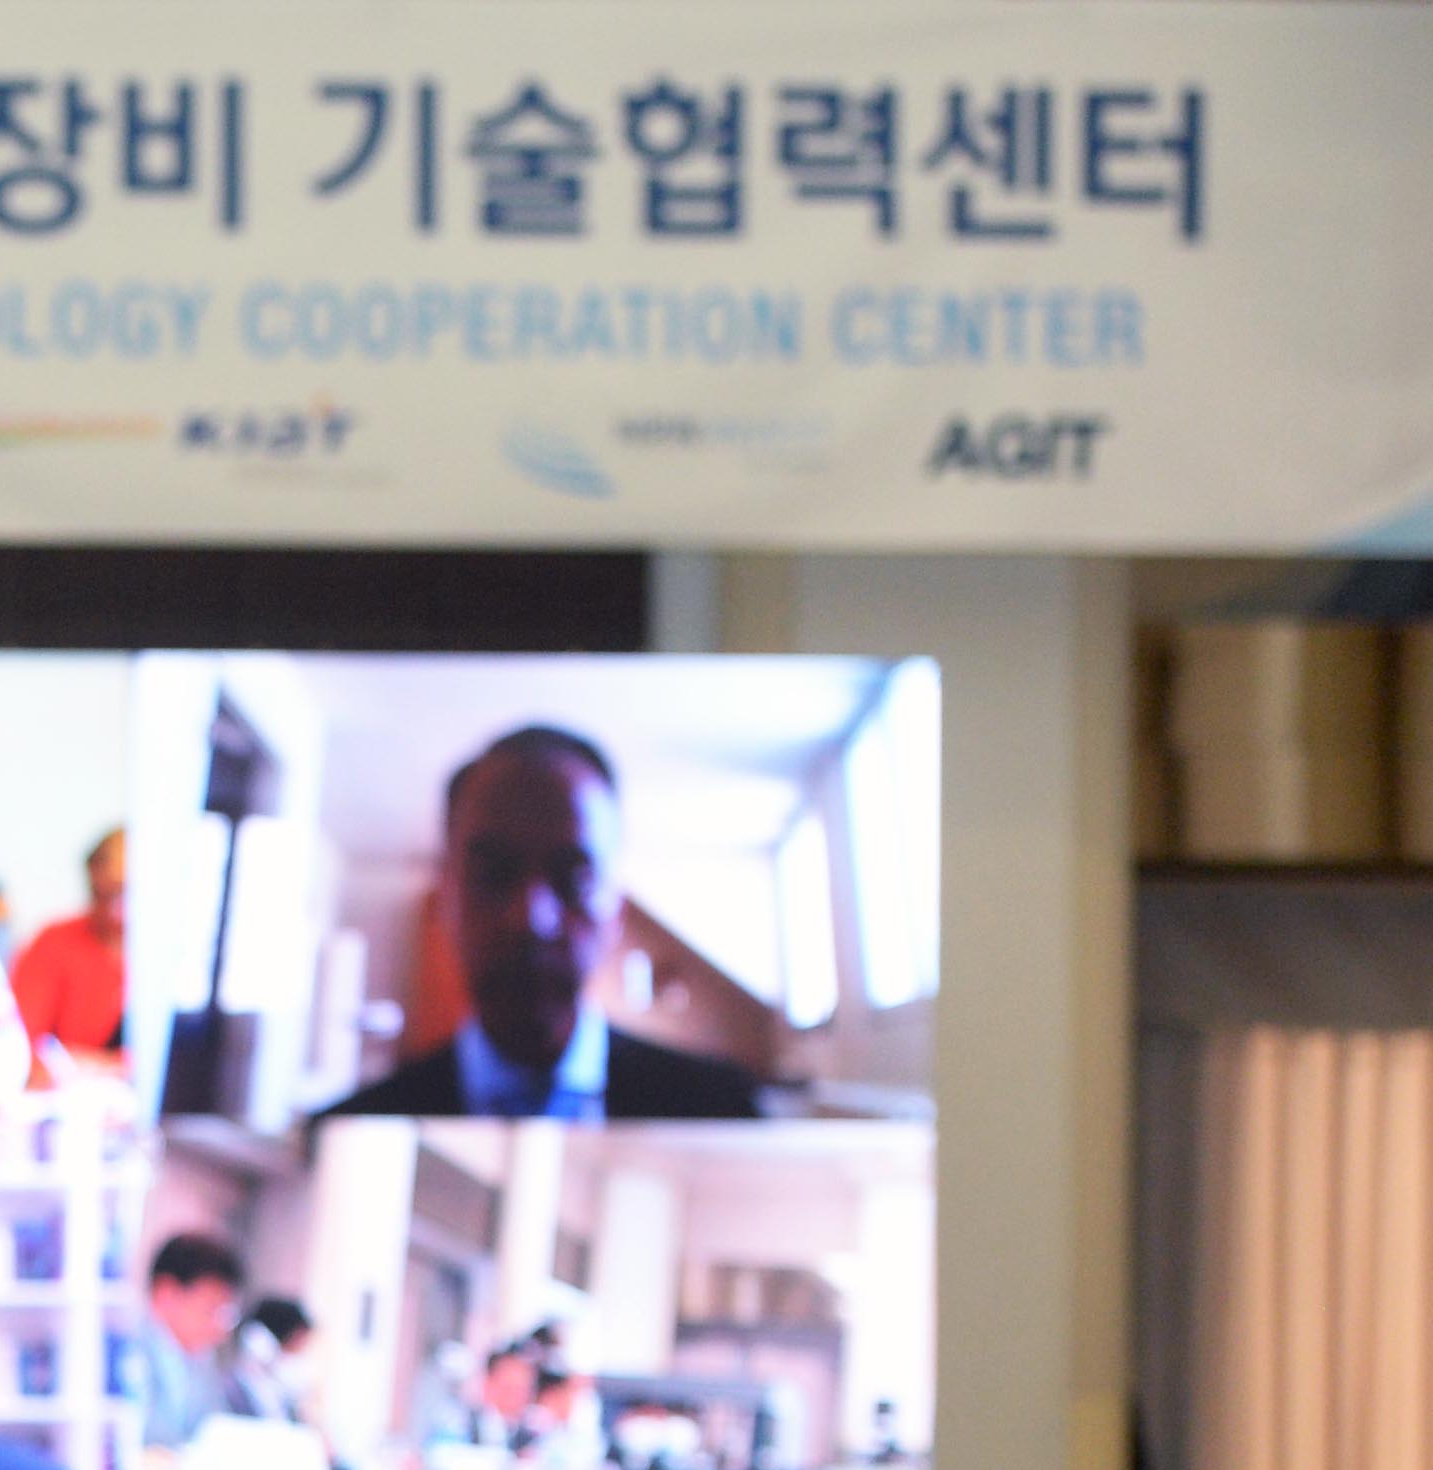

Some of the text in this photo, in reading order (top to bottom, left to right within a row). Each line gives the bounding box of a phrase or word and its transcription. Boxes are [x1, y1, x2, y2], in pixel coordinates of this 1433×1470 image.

[312, 75, 1210, 246] 기술협력센터
[239, 281, 806, 365] COOPERATION
[829, 287, 1147, 368] CENTER
[924, 412, 1111, 481] AGIT
